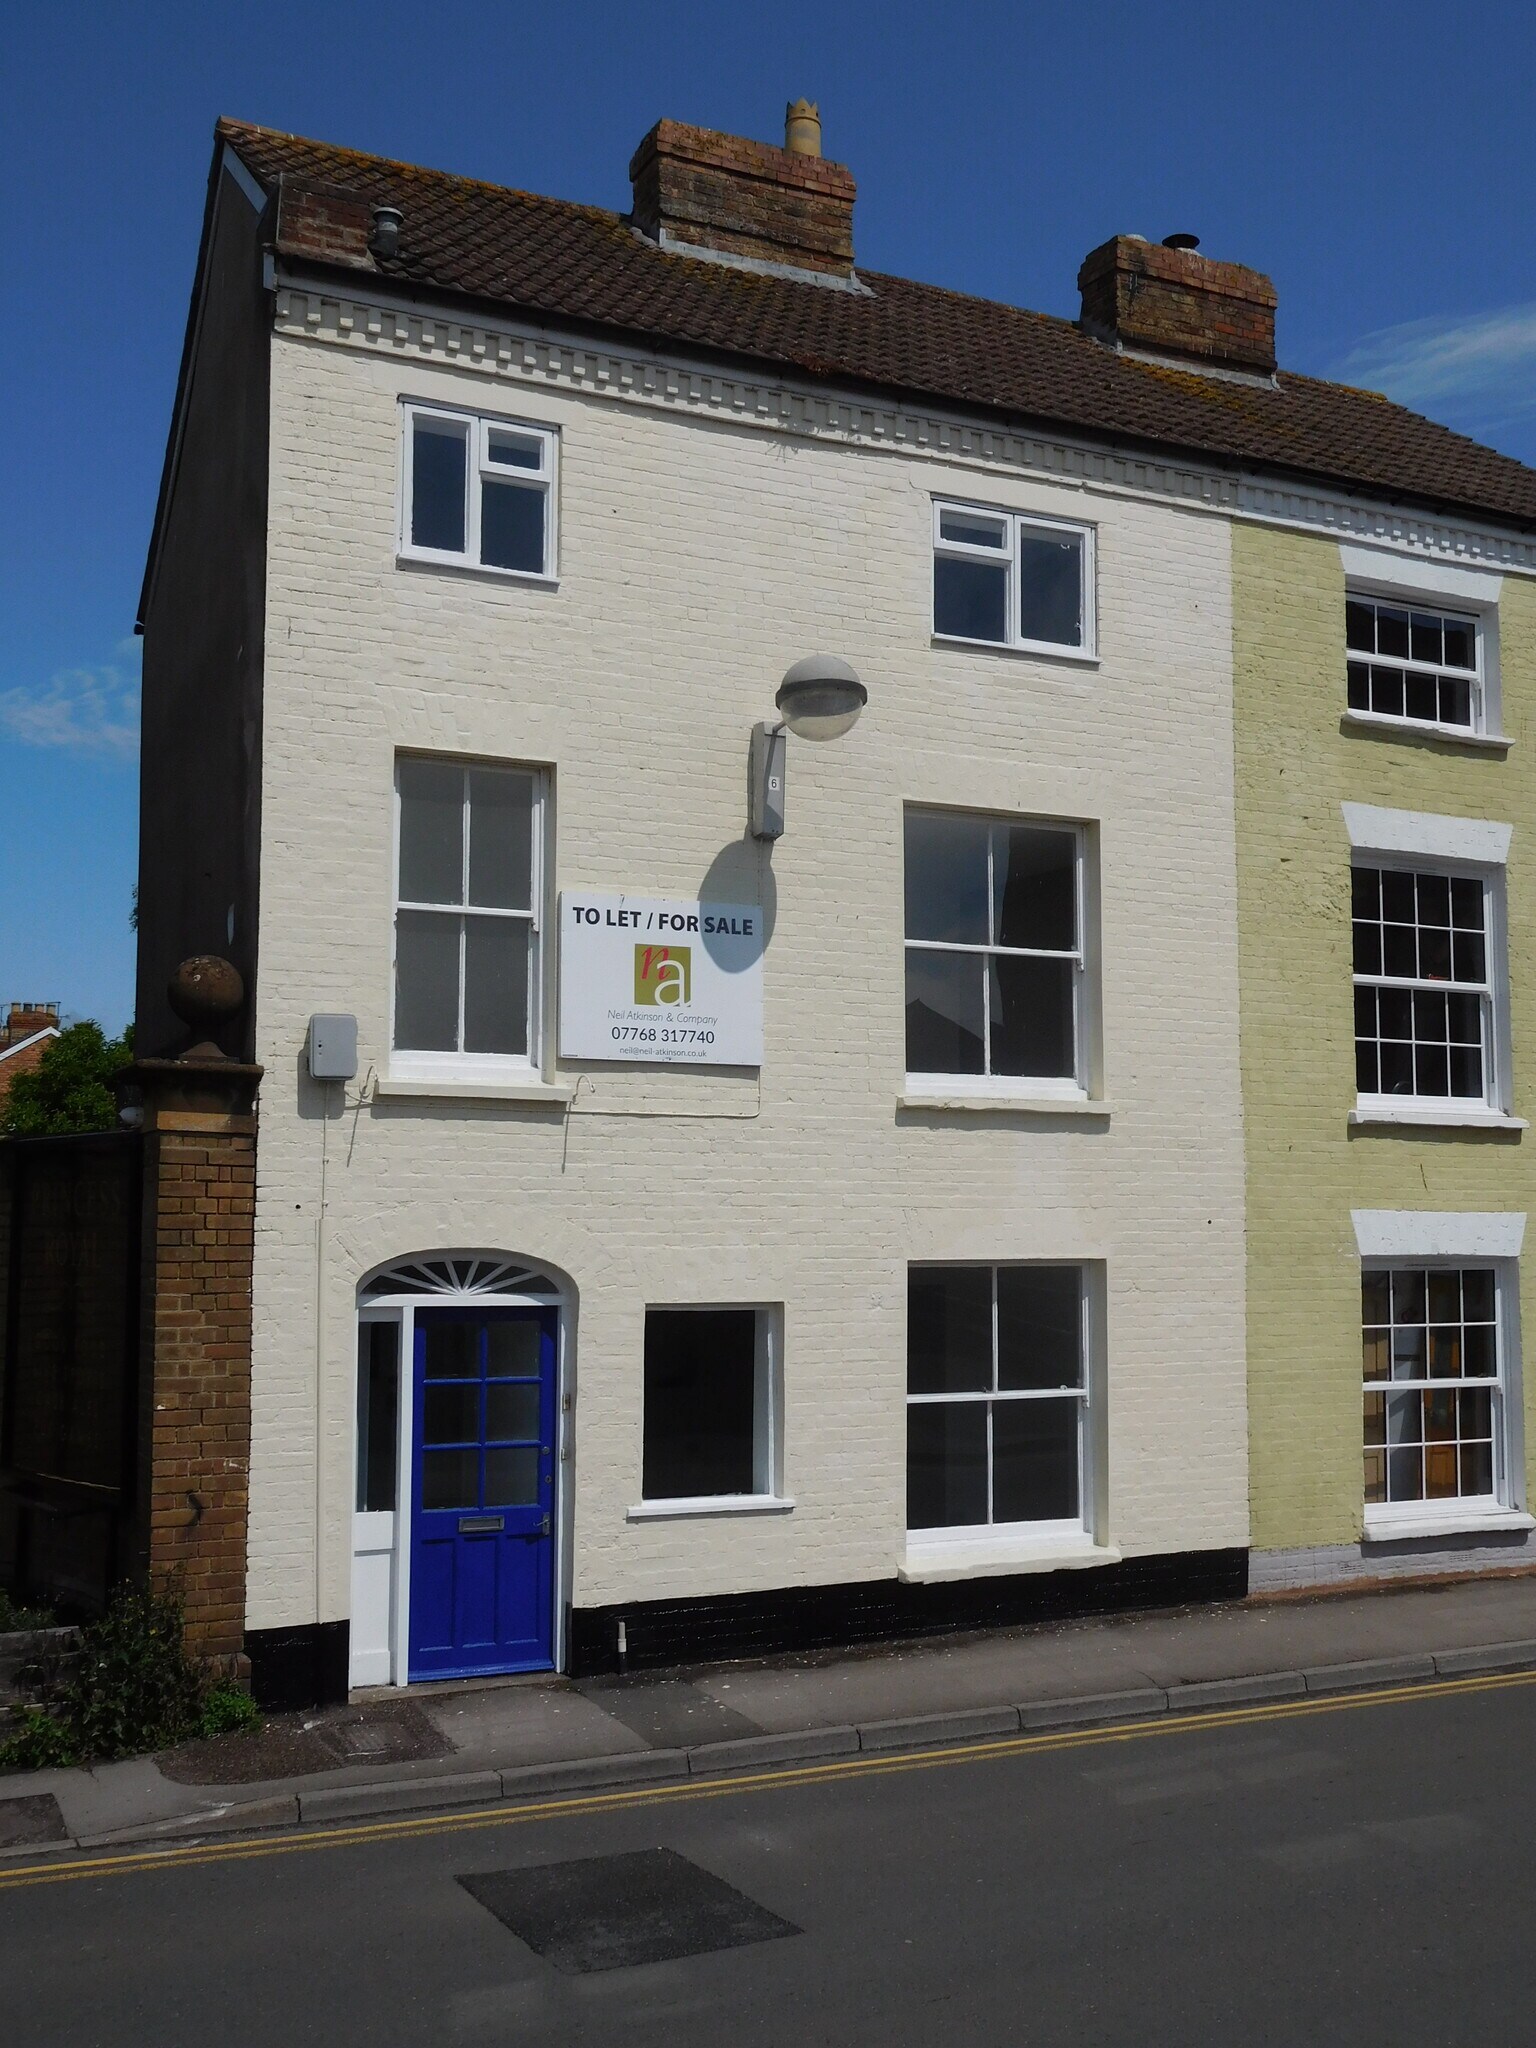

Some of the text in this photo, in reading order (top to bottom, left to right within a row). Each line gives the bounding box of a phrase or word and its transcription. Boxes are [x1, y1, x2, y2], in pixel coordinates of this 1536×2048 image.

[771, 778, 777, 788] 6
[572, 906, 753, 936] TO LET / FOR SALE
[607, 1009, 718, 1026] Neil Atkinson & Company
[611, 1026, 715, 1044] 07768 317740
[619, 1046, 707, 1057] neil@neil-atkinson.co.uk
